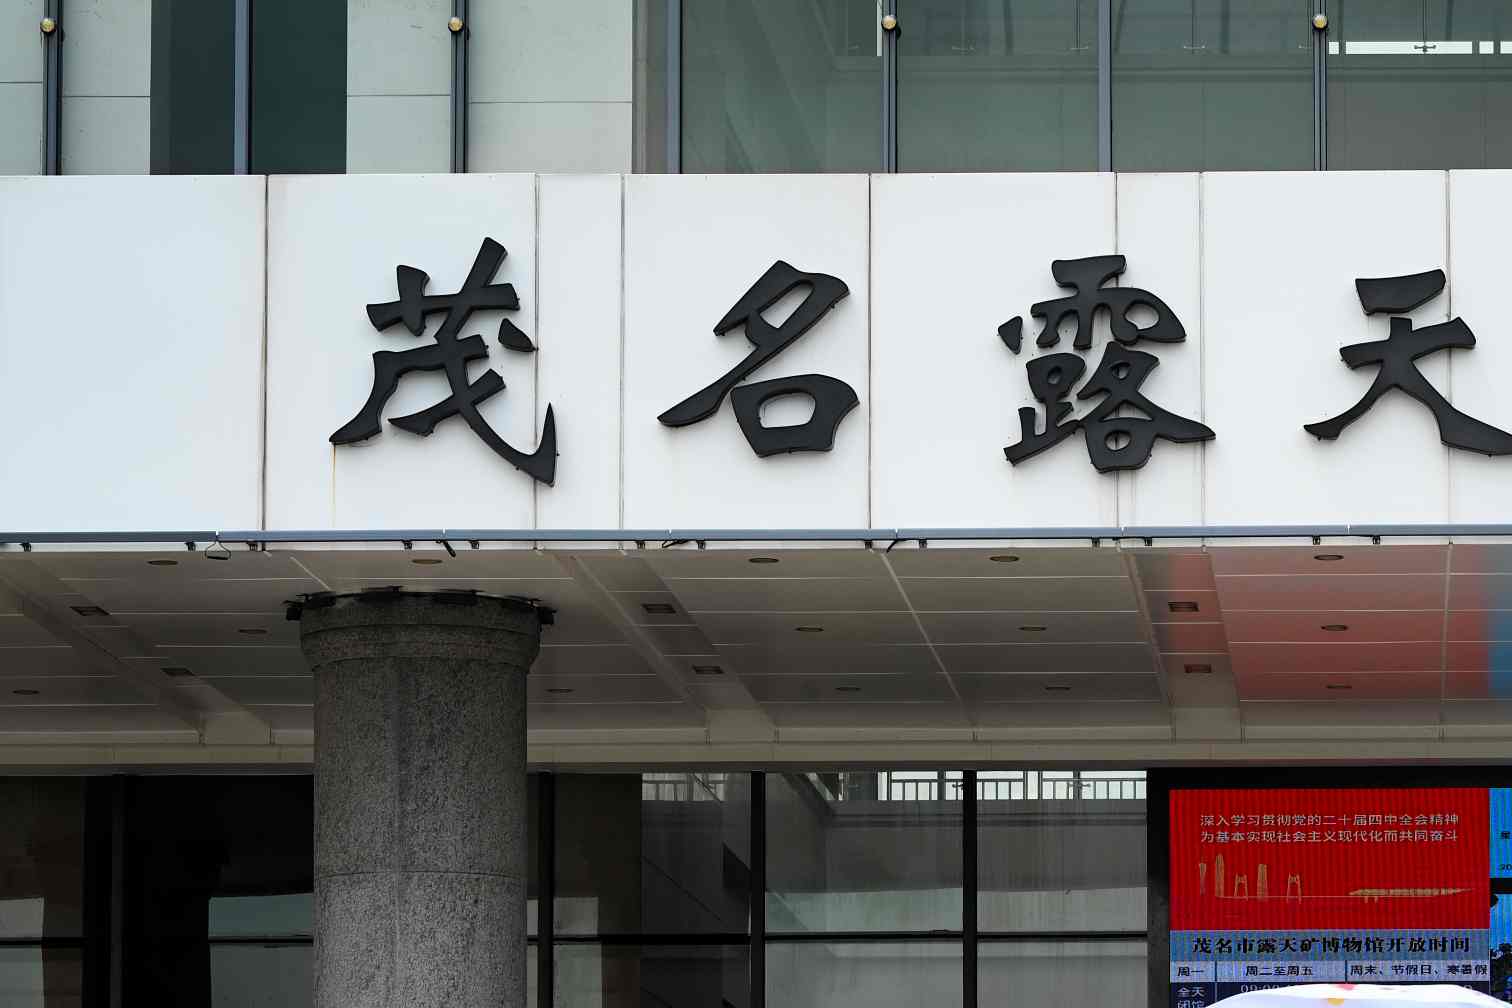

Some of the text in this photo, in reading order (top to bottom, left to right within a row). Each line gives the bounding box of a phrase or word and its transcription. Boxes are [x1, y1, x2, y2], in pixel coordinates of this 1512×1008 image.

[1200, 814, 1459, 827] 深入学习贯彻党的二十届四中全会精神
[1200, 830, 1459, 843] 为基本实现社会主义现代化而共同奋斗
[1192, 936, 1470, 954] 茂名市露天矿博物馆开放时间
[1177, 966, 1205, 977] 周一
[1245, 966, 1313, 977] 周二至周五
[1177, 987, 1205, 998] 全天
